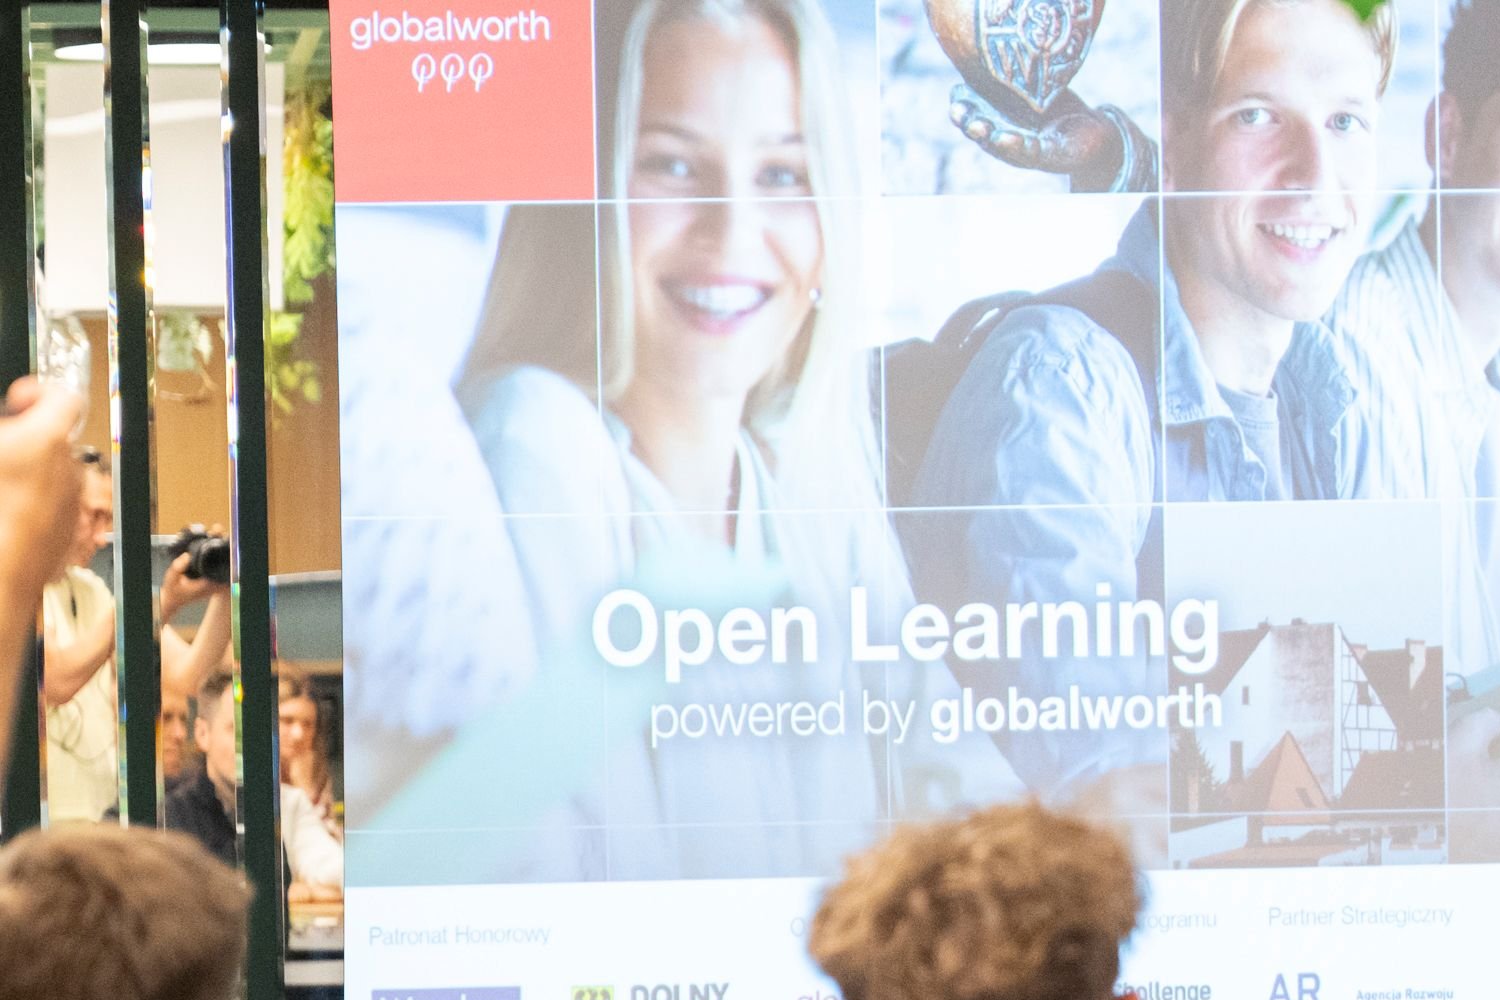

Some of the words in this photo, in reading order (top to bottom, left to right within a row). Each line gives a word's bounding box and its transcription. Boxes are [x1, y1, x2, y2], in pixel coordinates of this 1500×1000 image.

[350, 9, 551, 50] globalworth
[592, 588, 818, 684] Open
[850, 581, 1219, 674] Learning
[651, 689, 846, 749] powered
[863, 689, 916, 744] by
[930, 683, 1223, 744] globalworth
[368, 926, 448, 946] Patronat
[455, 924, 552, 947] Honorowy
[1267, 906, 1335, 928] Partner
[1341, 905, 1455, 928] Strategiczny
